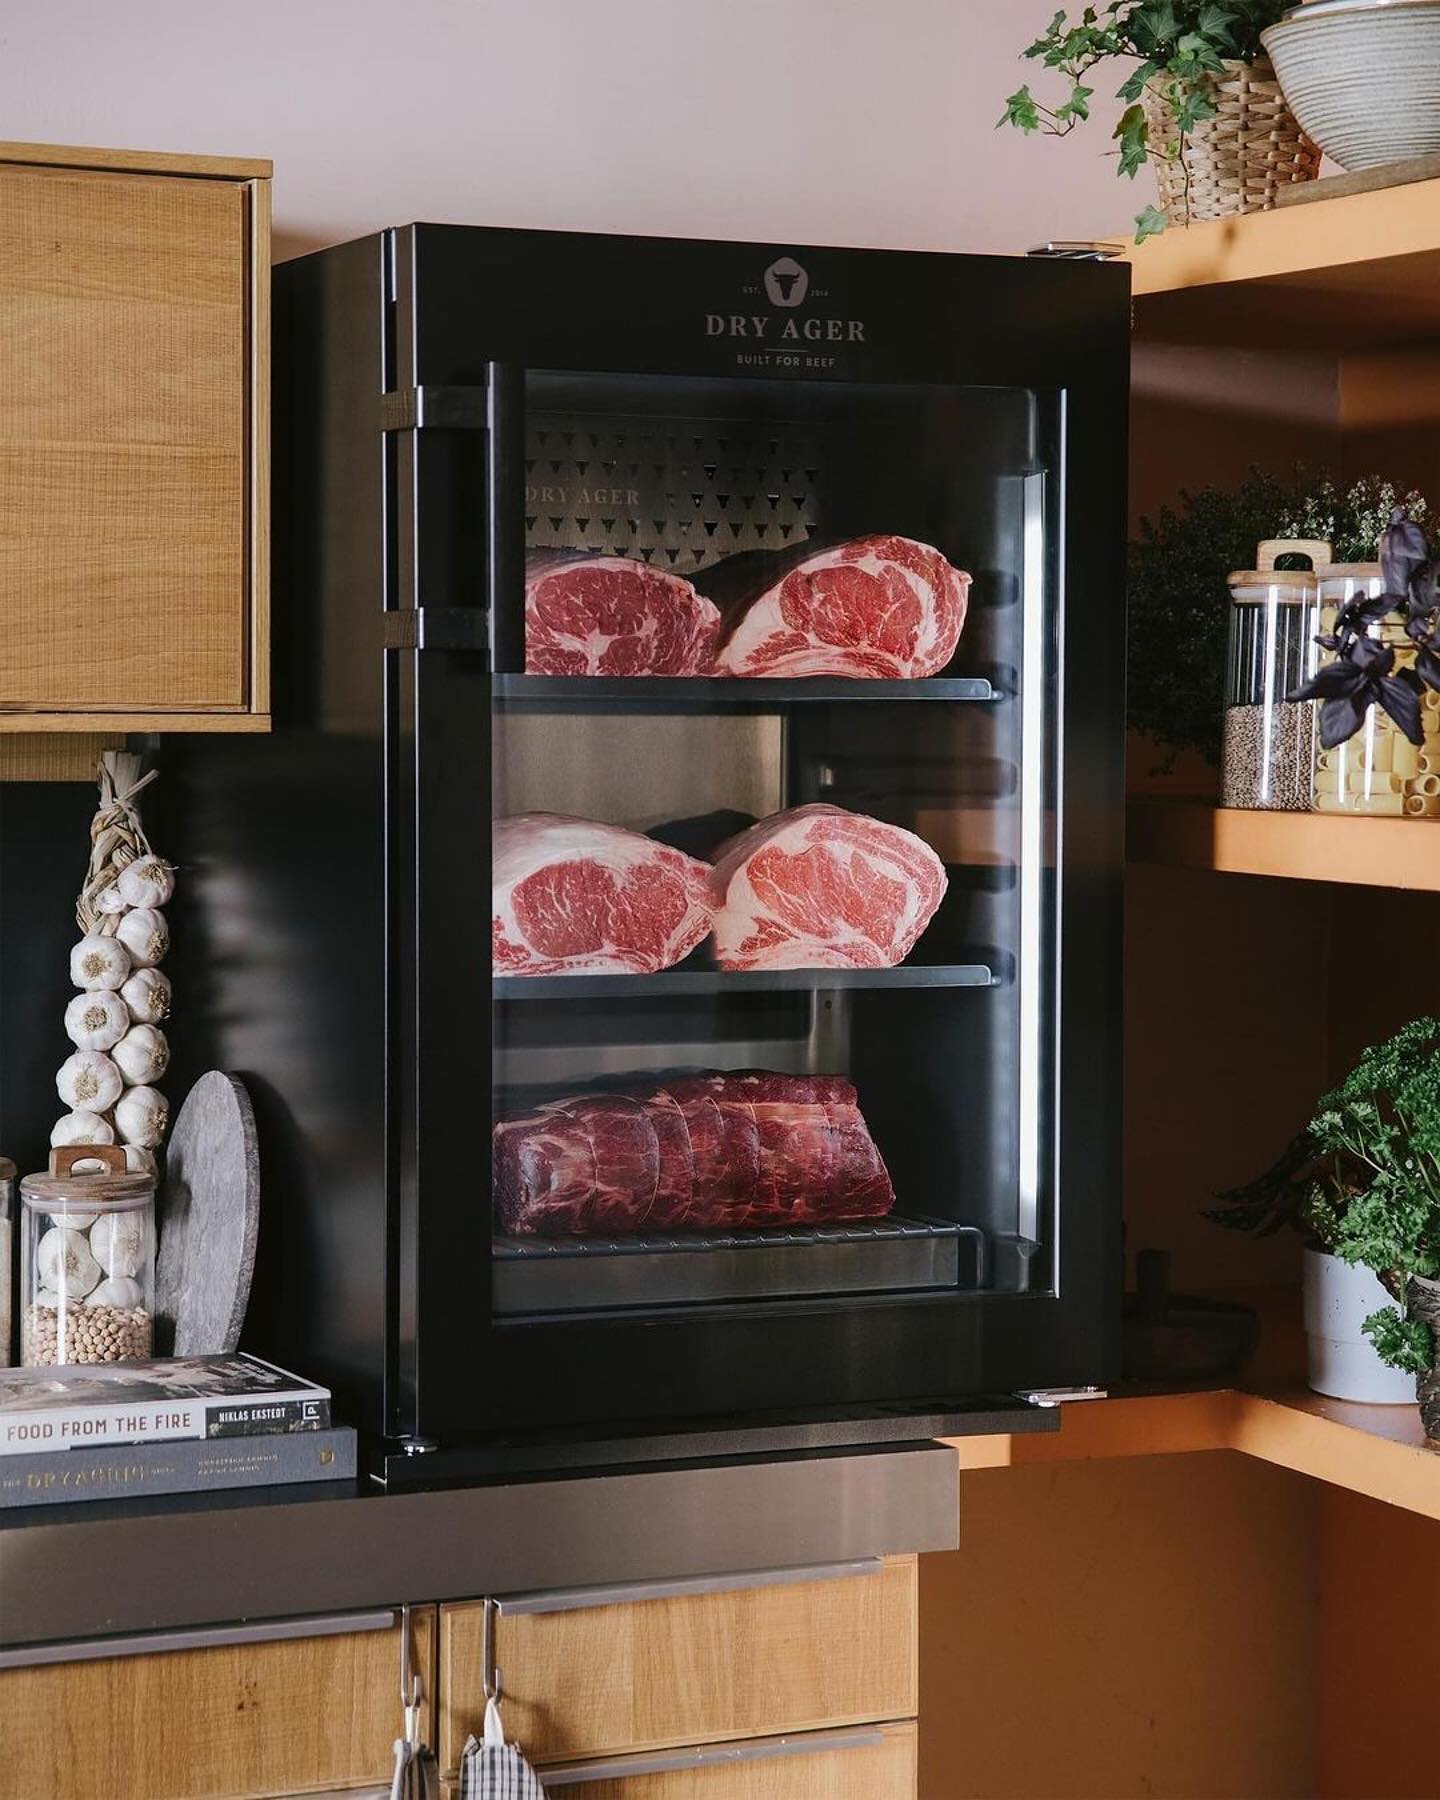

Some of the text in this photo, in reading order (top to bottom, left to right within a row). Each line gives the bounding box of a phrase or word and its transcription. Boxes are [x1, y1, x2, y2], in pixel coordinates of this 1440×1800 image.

[705, 314, 865, 341] DRY AGER
[737, 354, 835, 367] BUILT FOR BEEF
[580, 488, 641, 505] AGER
[219, 1410, 249, 1423] NIKLAS
[7, 1412, 191, 1441] FOOD FROM THE FIRE
